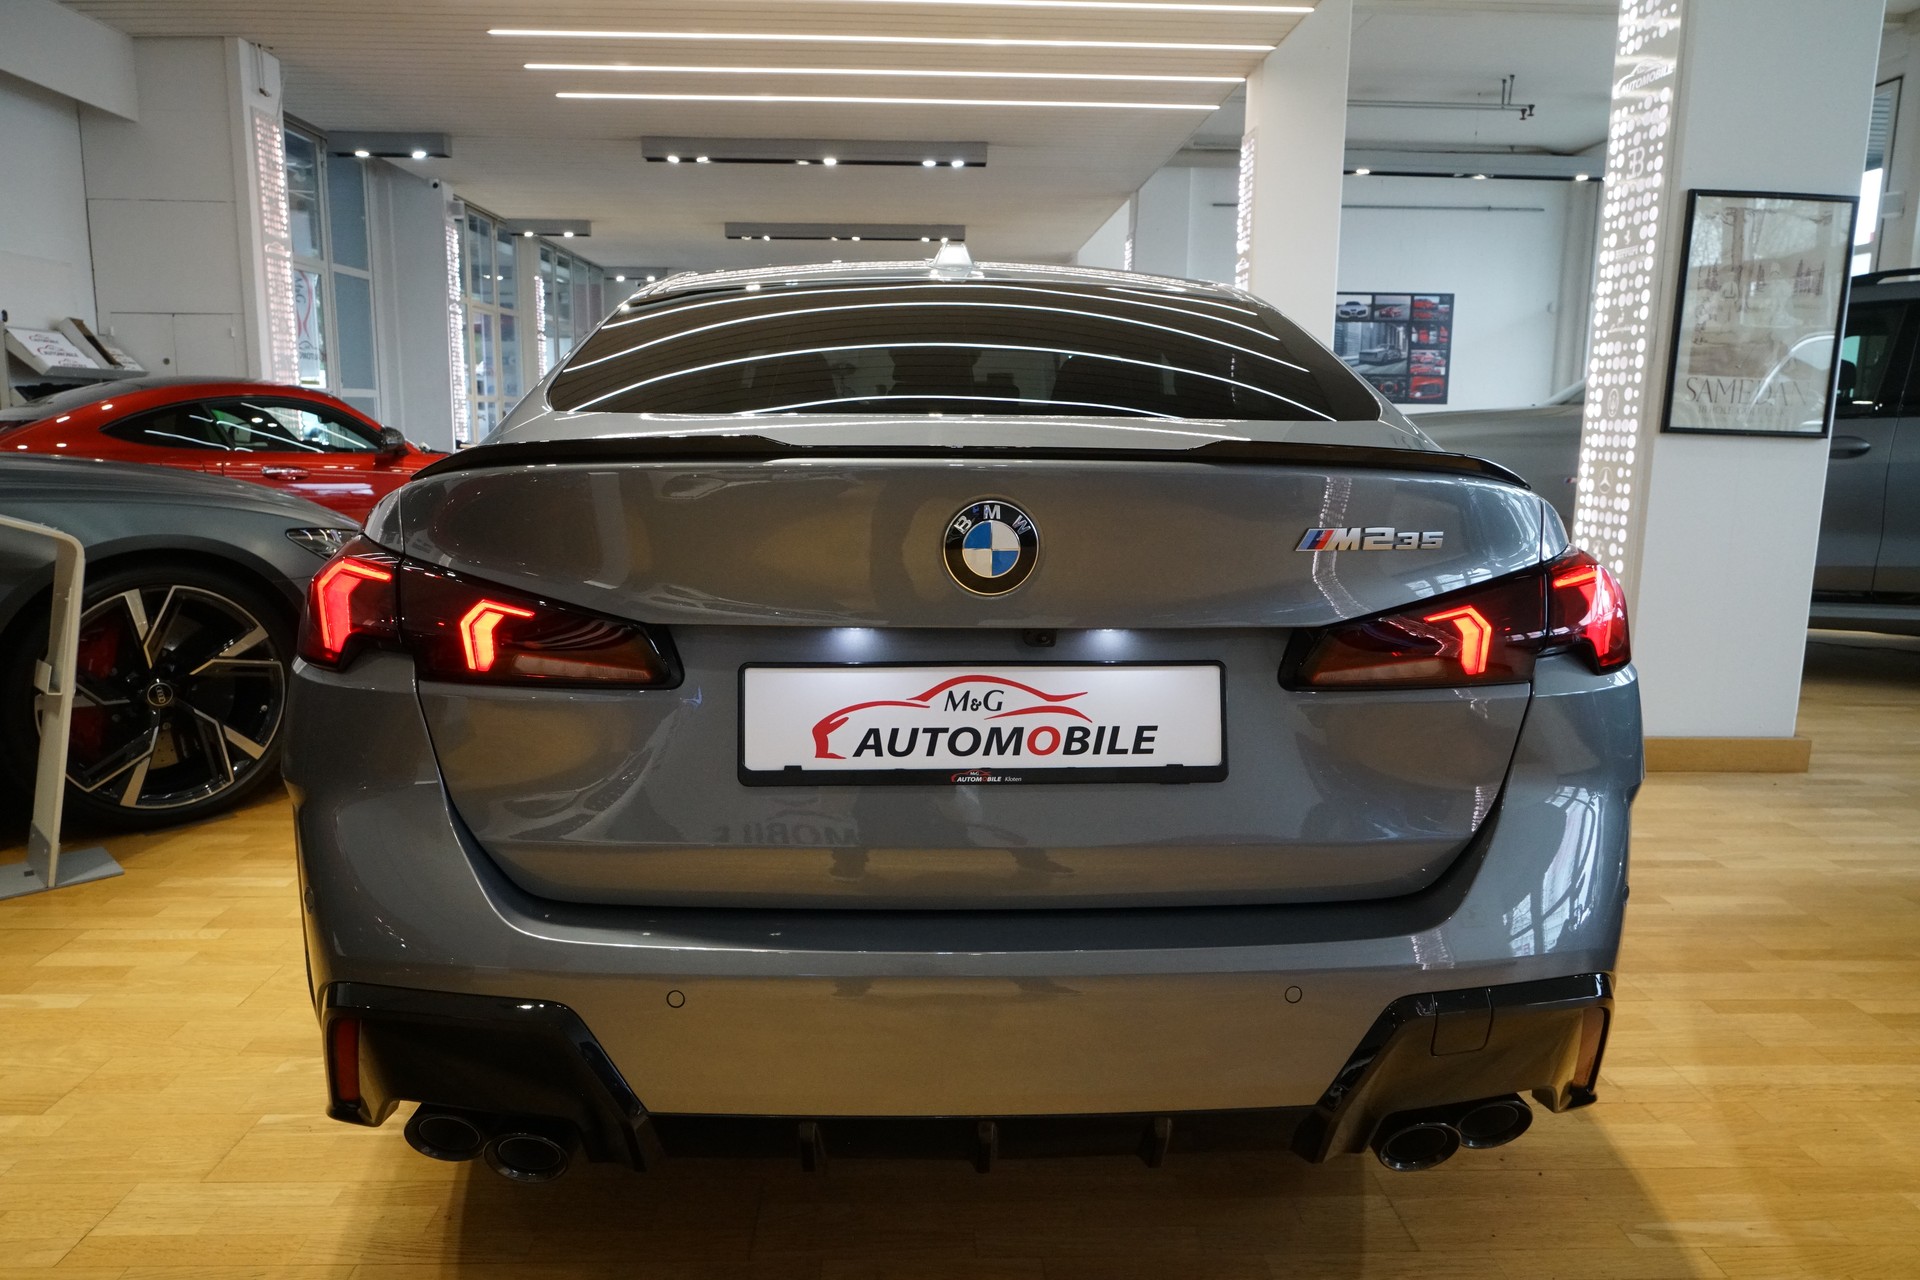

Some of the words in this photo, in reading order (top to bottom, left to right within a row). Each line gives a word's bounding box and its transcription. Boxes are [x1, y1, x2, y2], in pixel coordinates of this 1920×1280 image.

[954, 505, 1031, 534] BMW
[1323, 527, 1444, 551] M235
[944, 690, 1004, 712] M&G
[852, 725, 1159, 758] AUTOMOBILE
